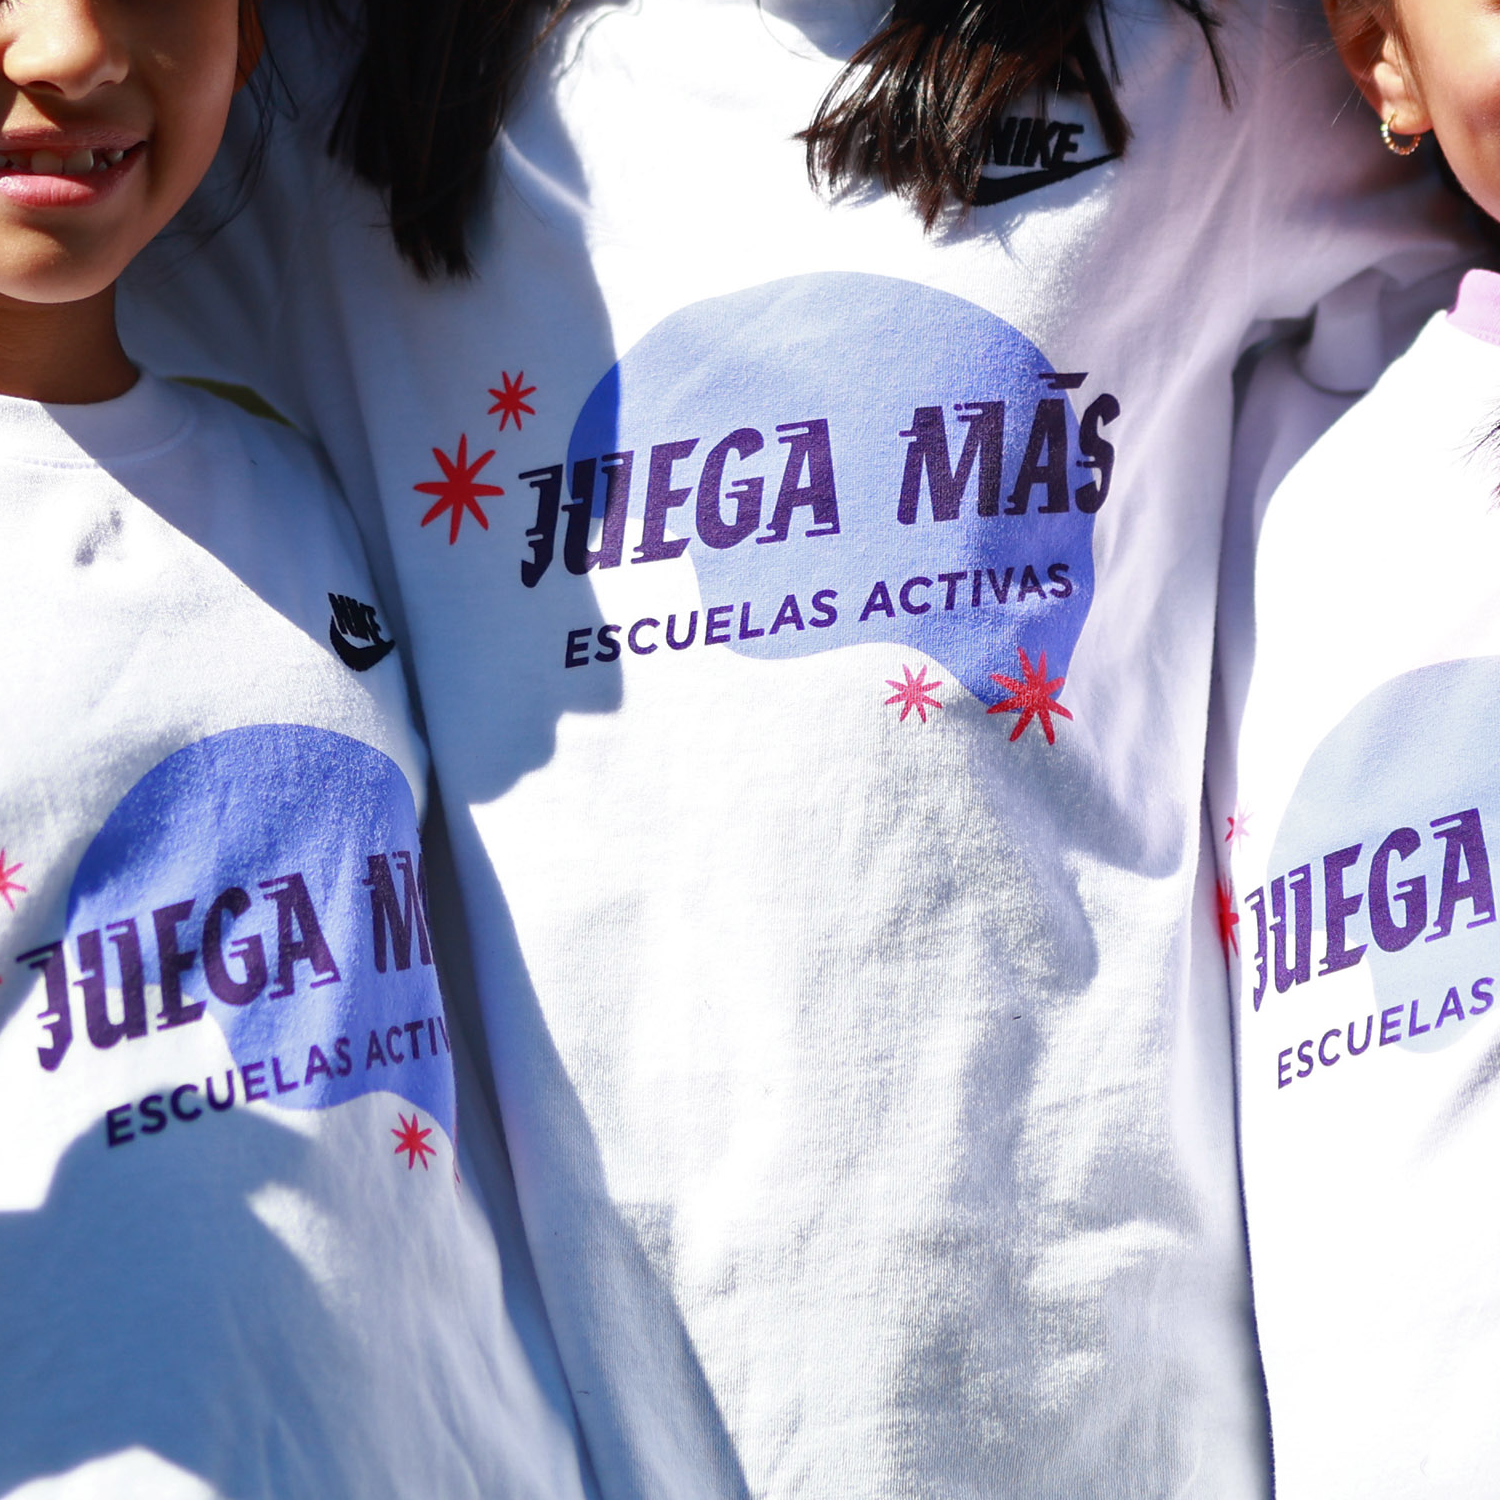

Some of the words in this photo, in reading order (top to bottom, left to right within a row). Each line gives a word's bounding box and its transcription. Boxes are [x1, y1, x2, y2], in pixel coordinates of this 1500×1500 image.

[983, 116, 1085, 171] NIKE
[517, 417, 841, 589] JUEGA
[896, 371, 1121, 526] MÁS
[564, 588, 839, 669] ESCUELAS
[858, 562, 1074, 622] ACTIVAS
[1244, 807, 1497, 1013] JUEGA
[16, 871, 342, 1073] JUEGA
[1277, 976, 1495, 1090] ESCUELAS
[104, 1035, 353, 1148] ESCUELAS
